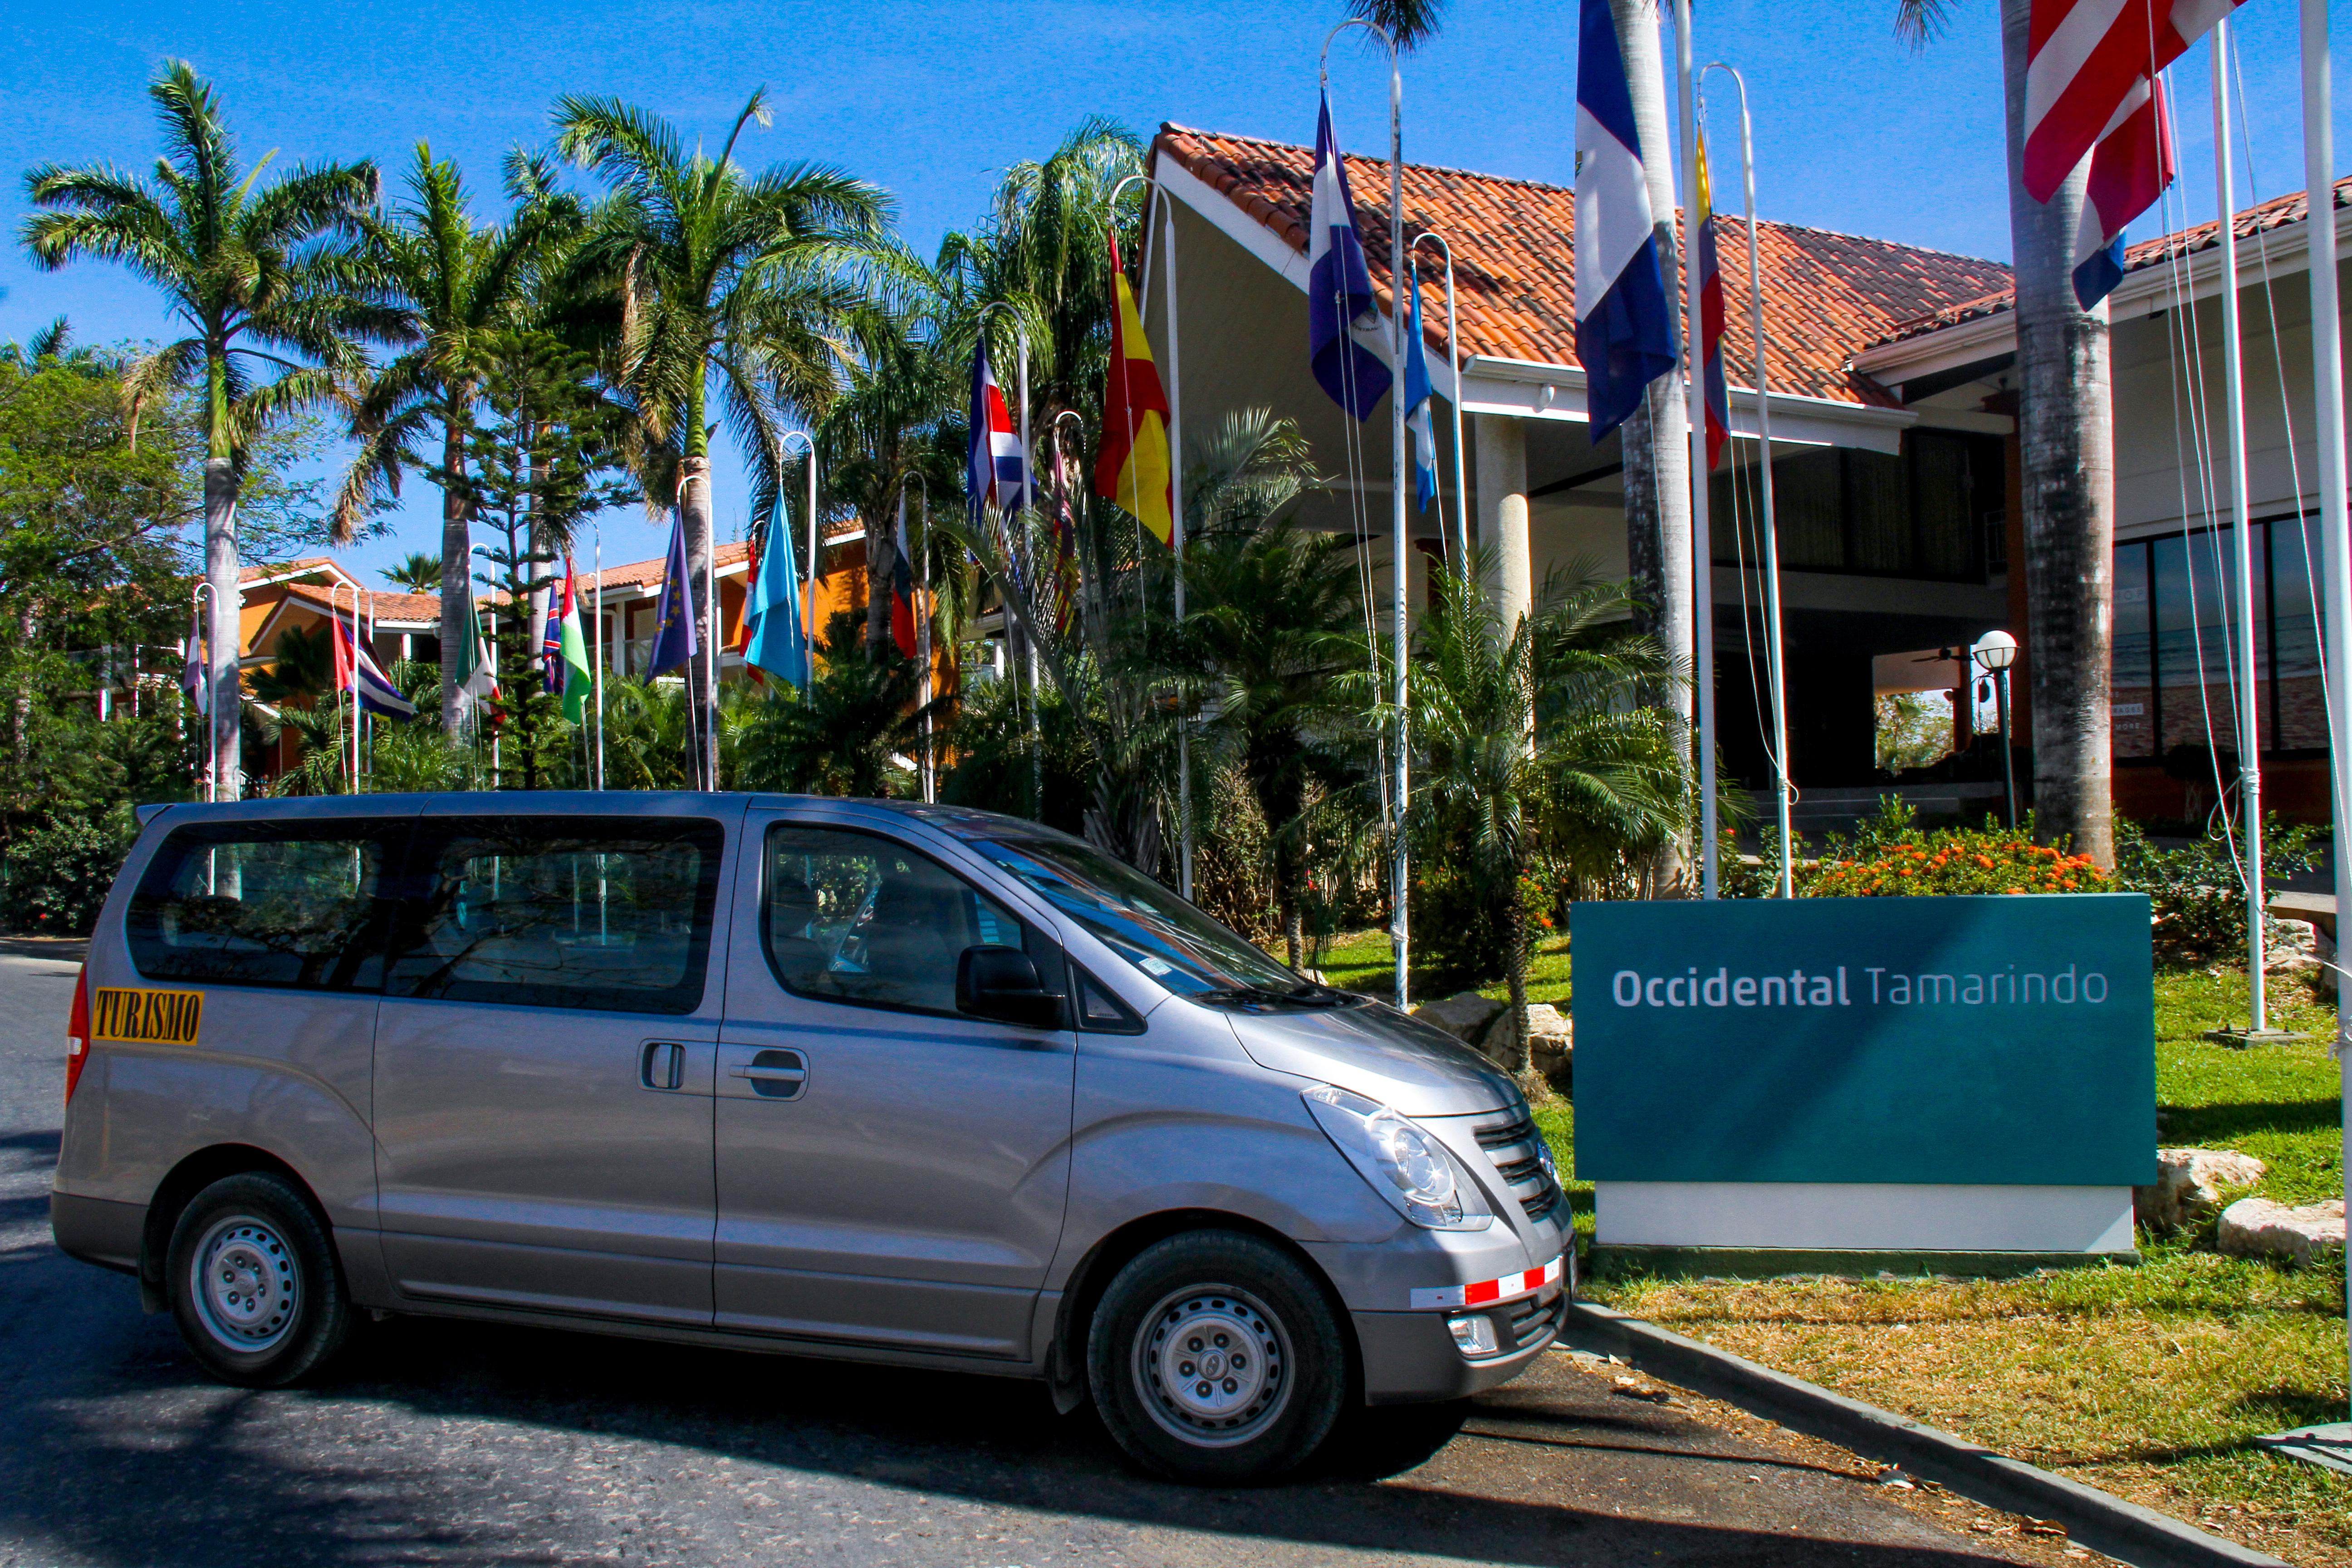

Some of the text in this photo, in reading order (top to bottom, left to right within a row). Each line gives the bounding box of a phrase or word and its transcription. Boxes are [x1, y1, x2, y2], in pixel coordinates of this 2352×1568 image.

[1612, 963, 2108, 1007] Occidental Tamarindo
[97, 990, 200, 1042] TURISMO
